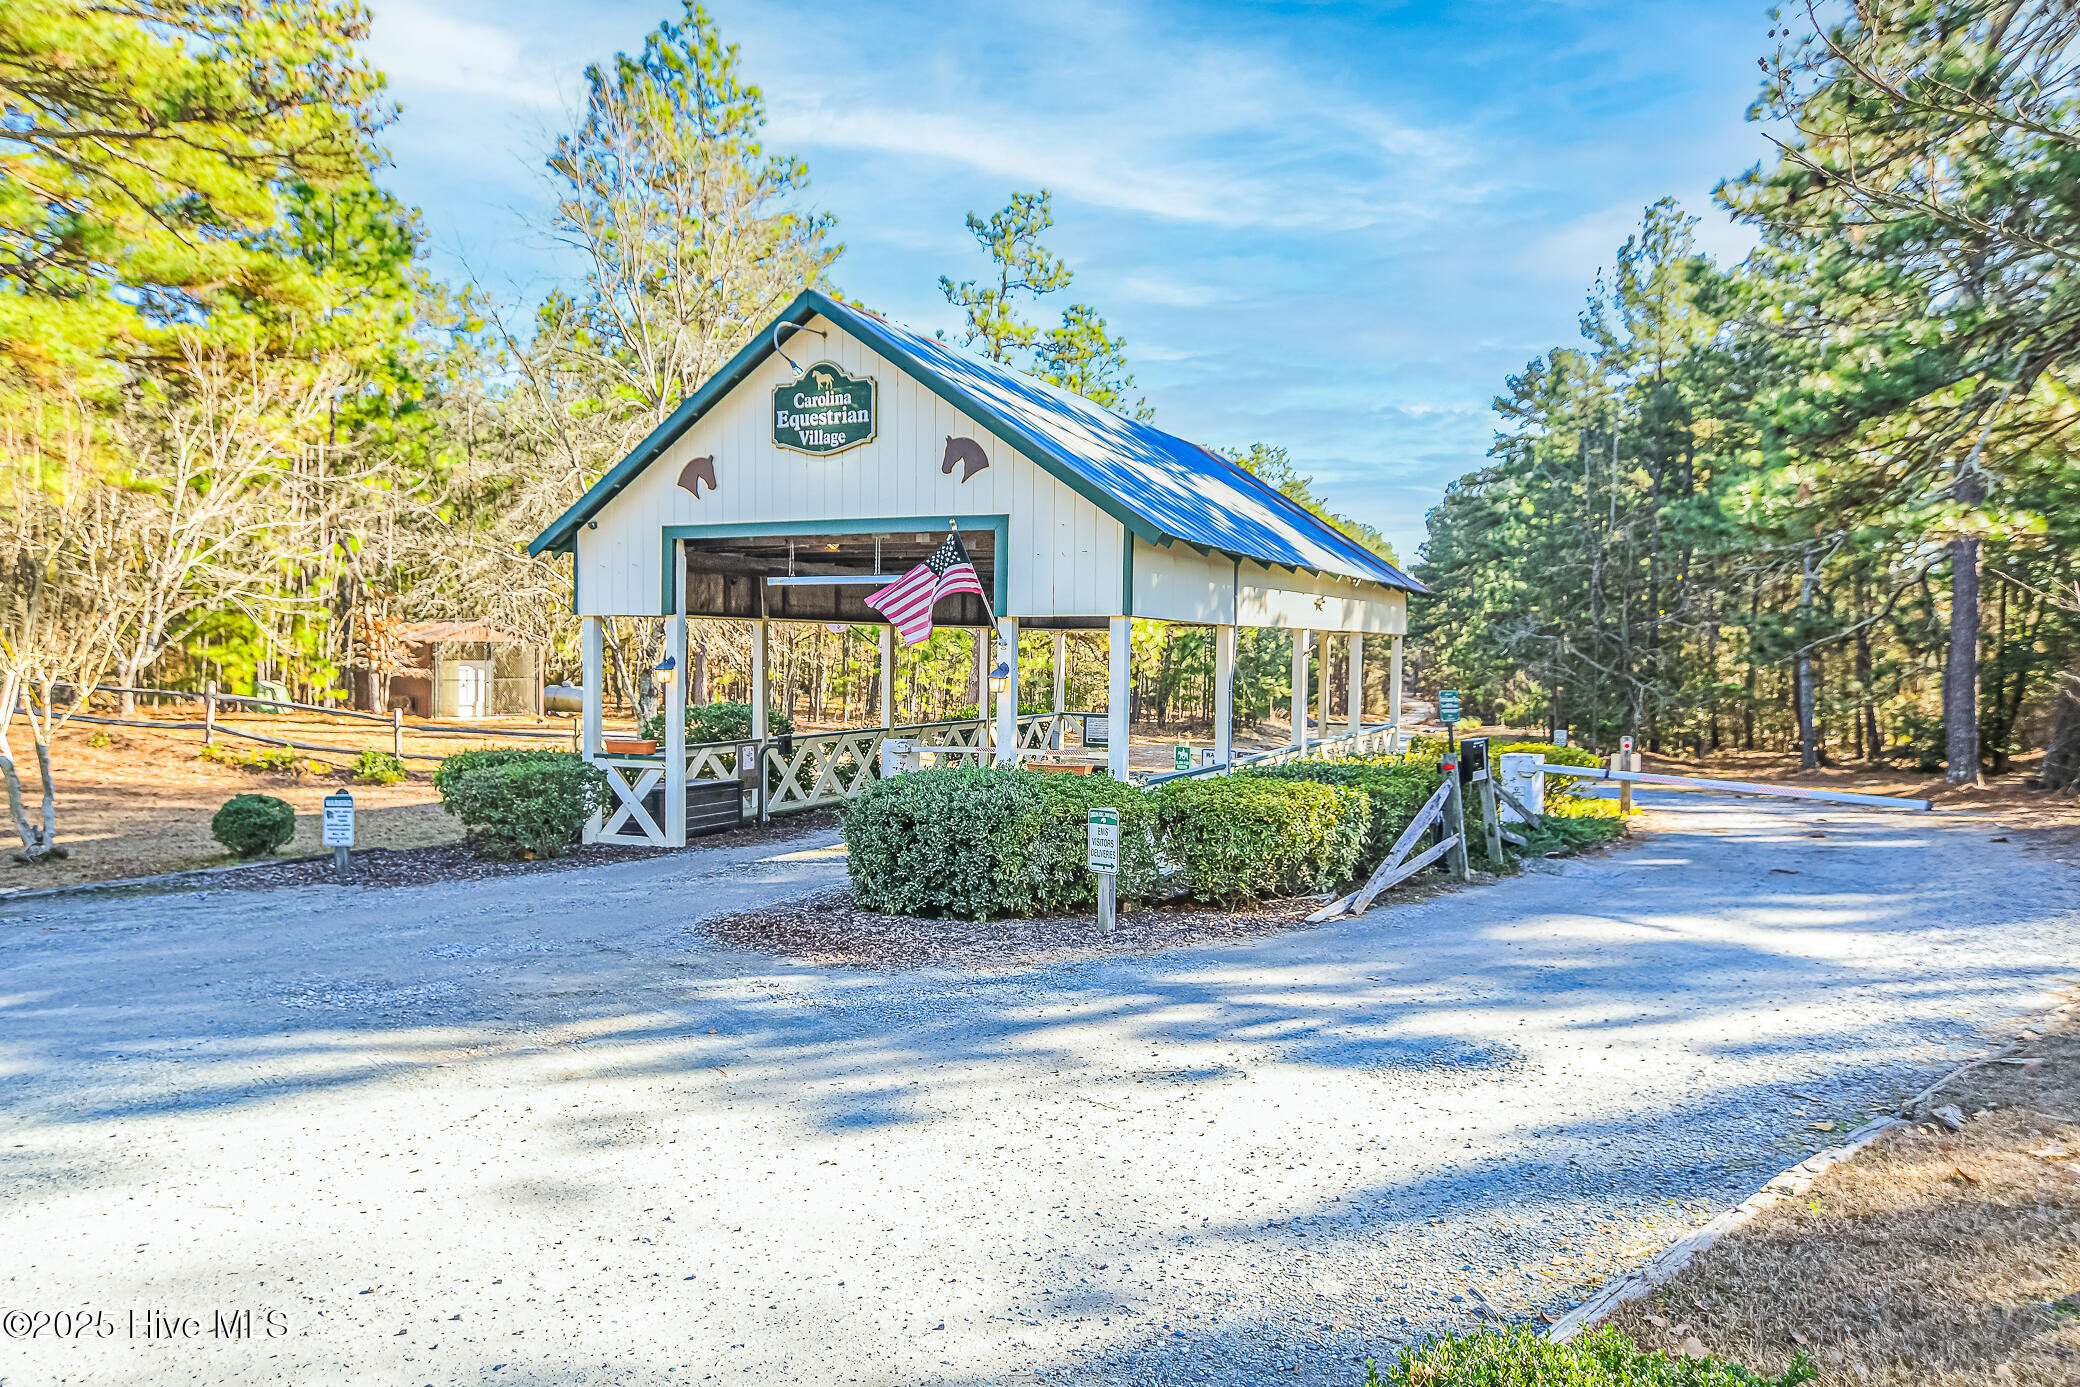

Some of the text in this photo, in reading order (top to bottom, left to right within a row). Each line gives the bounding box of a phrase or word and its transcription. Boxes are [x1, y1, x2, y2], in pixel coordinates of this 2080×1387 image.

[793, 390, 852, 409] Carolina
[776, 405, 870, 431] Equestrian
[799, 428, 846, 447] Village
[1097, 827, 1109, 836] EMS
[1091, 837, 1114, 848] VISITORS
[1090, 848, 1116, 860] DELIVERIES
